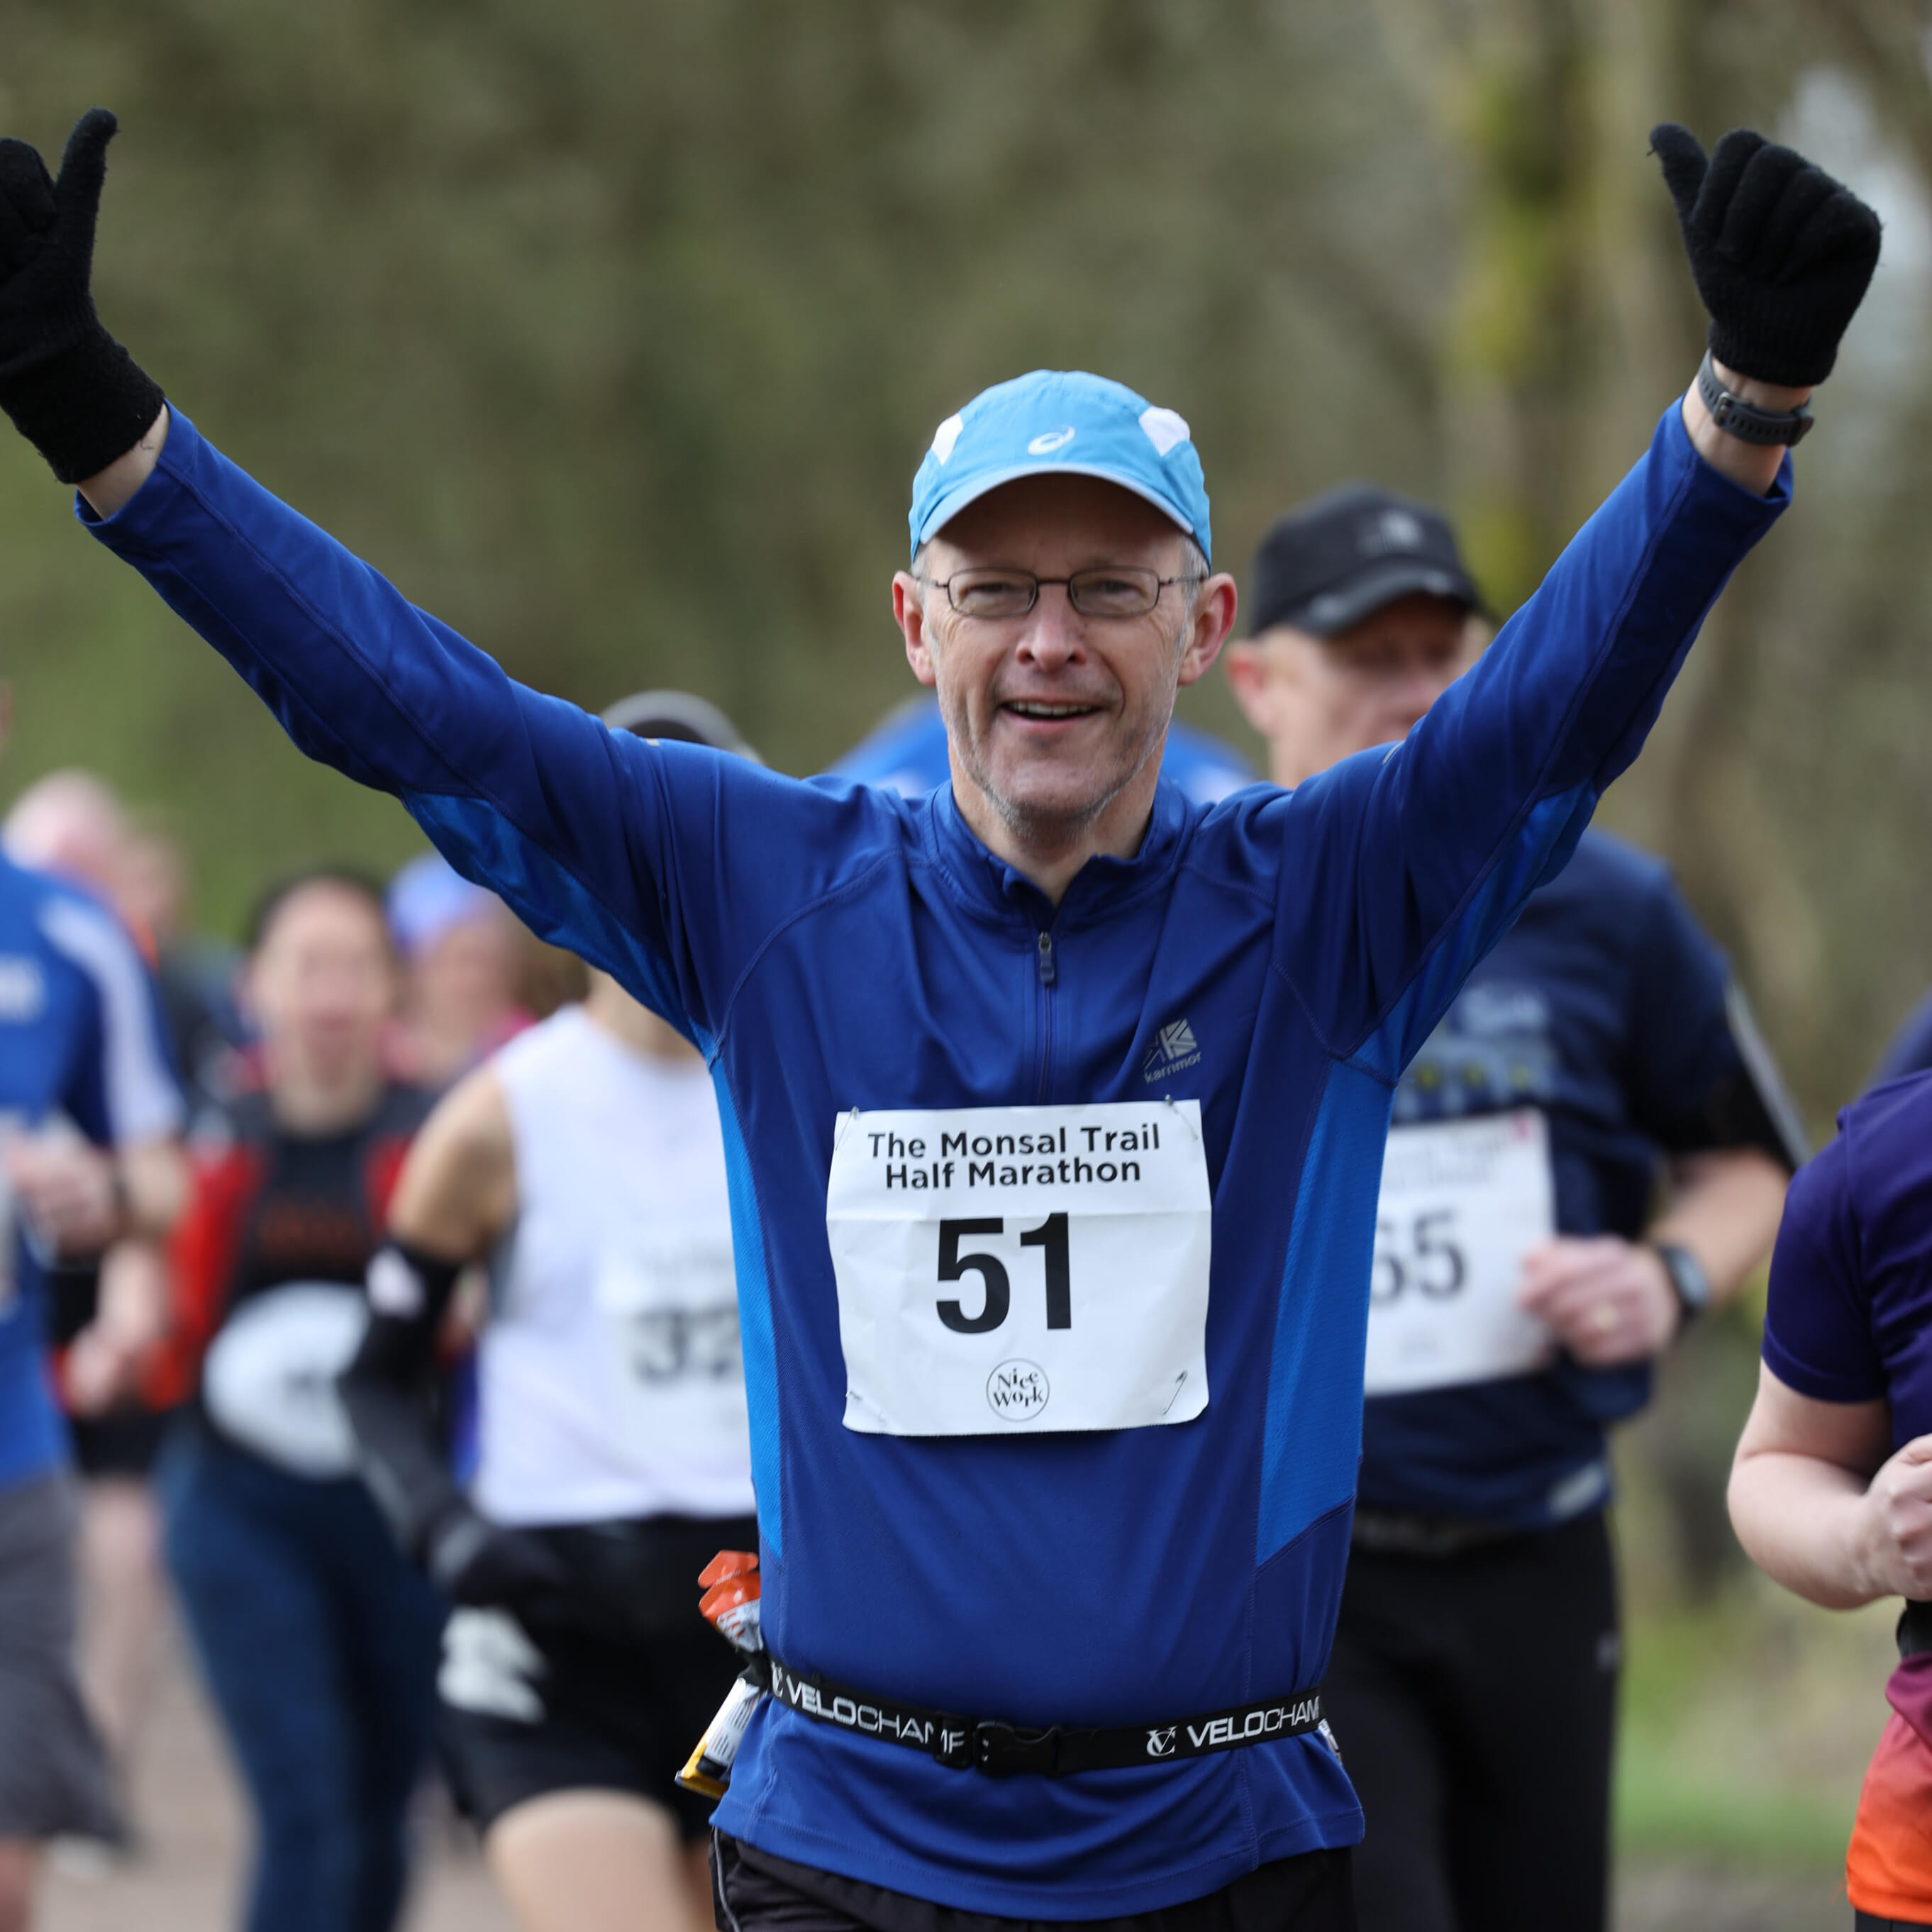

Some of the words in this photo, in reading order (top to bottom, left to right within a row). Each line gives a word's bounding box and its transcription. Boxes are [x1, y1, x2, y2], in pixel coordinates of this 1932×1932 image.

[867, 1132, 926, 1158] The
[941, 1126, 1066, 1158] Monsal
[1079, 1123, 1160, 1153] Trail
[886, 1161, 955, 1189] Half
[968, 1157, 1141, 1188] Marathon
[936, 1211, 1072, 1334] 51
[997, 1367, 1039, 1390] Nice
[993, 1385, 1043, 1408] Work
